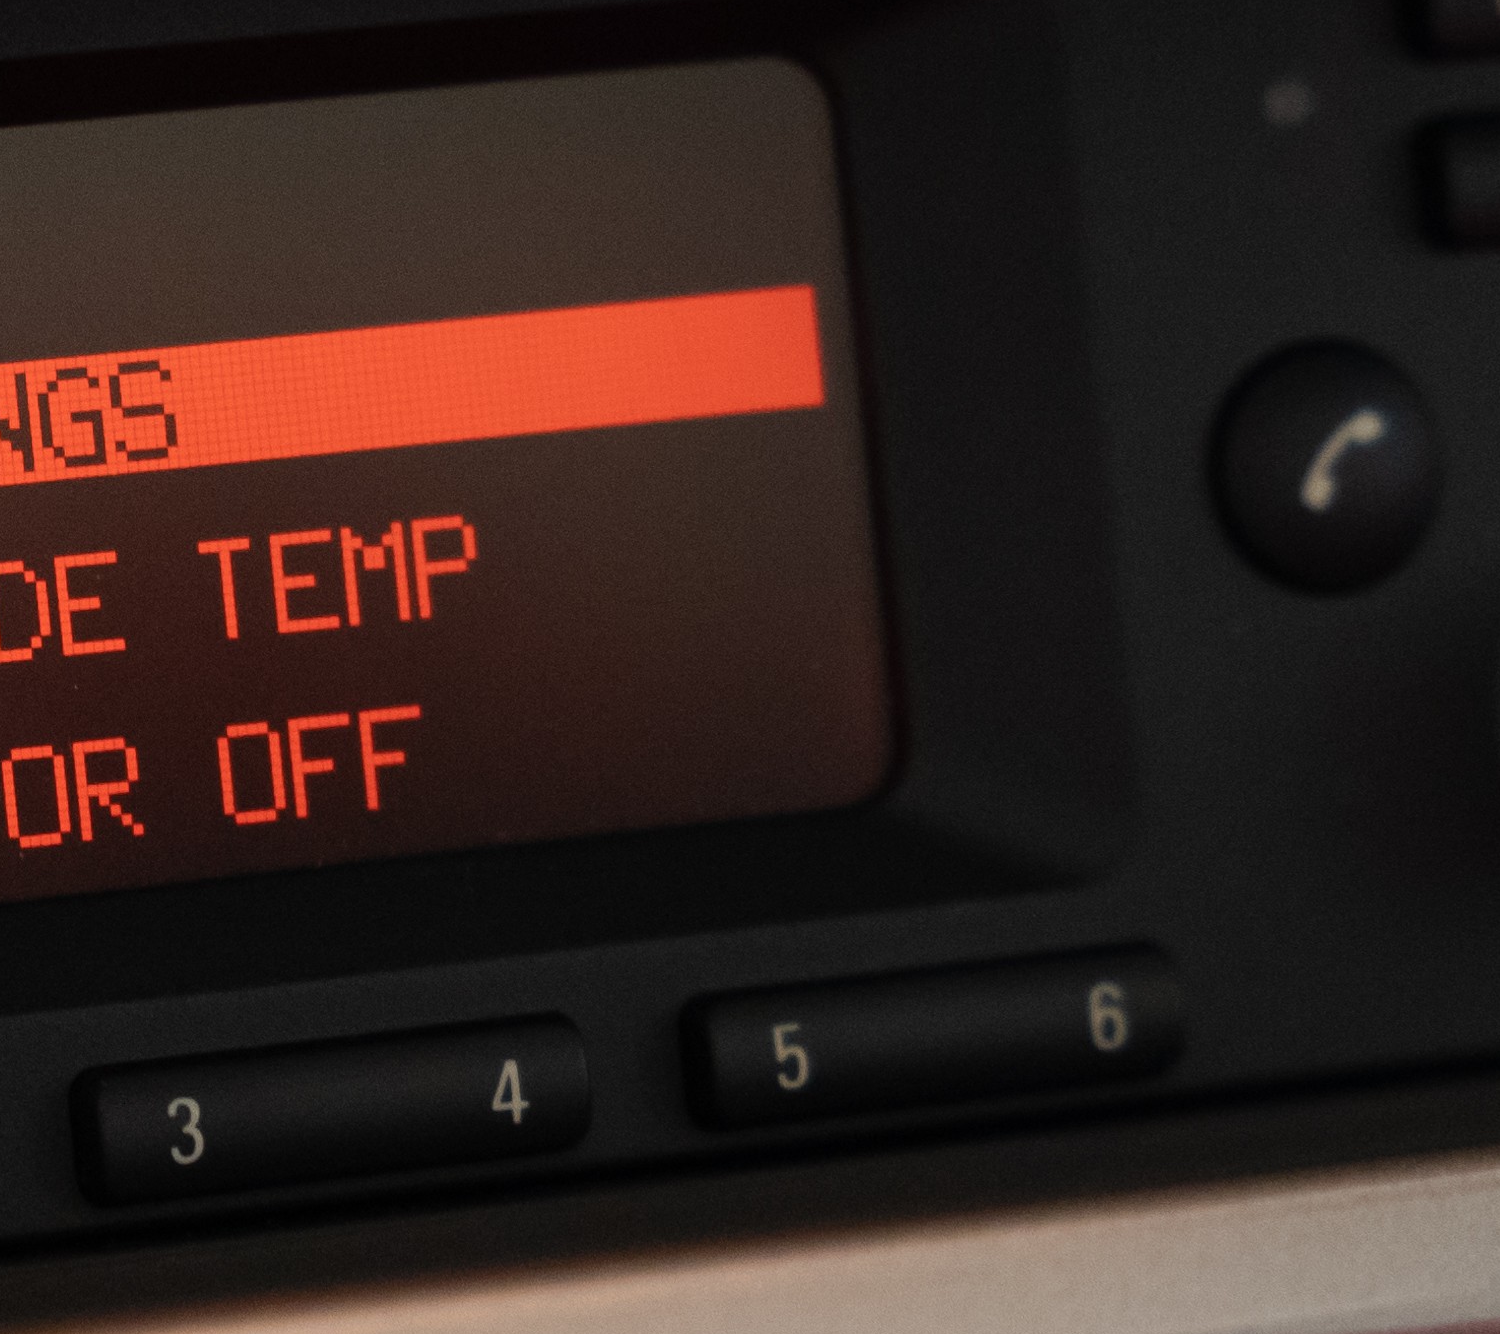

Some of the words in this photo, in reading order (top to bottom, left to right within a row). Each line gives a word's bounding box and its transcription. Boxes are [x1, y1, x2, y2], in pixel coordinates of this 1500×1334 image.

[197, 515, 477, 639] TEMP
[217, 705, 421, 825] OFF
[771, 1020, 813, 1091] 5
[1085, 979, 1130, 1051] 6
[165, 1094, 207, 1166] 3
[488, 1056, 531, 1127] 4
